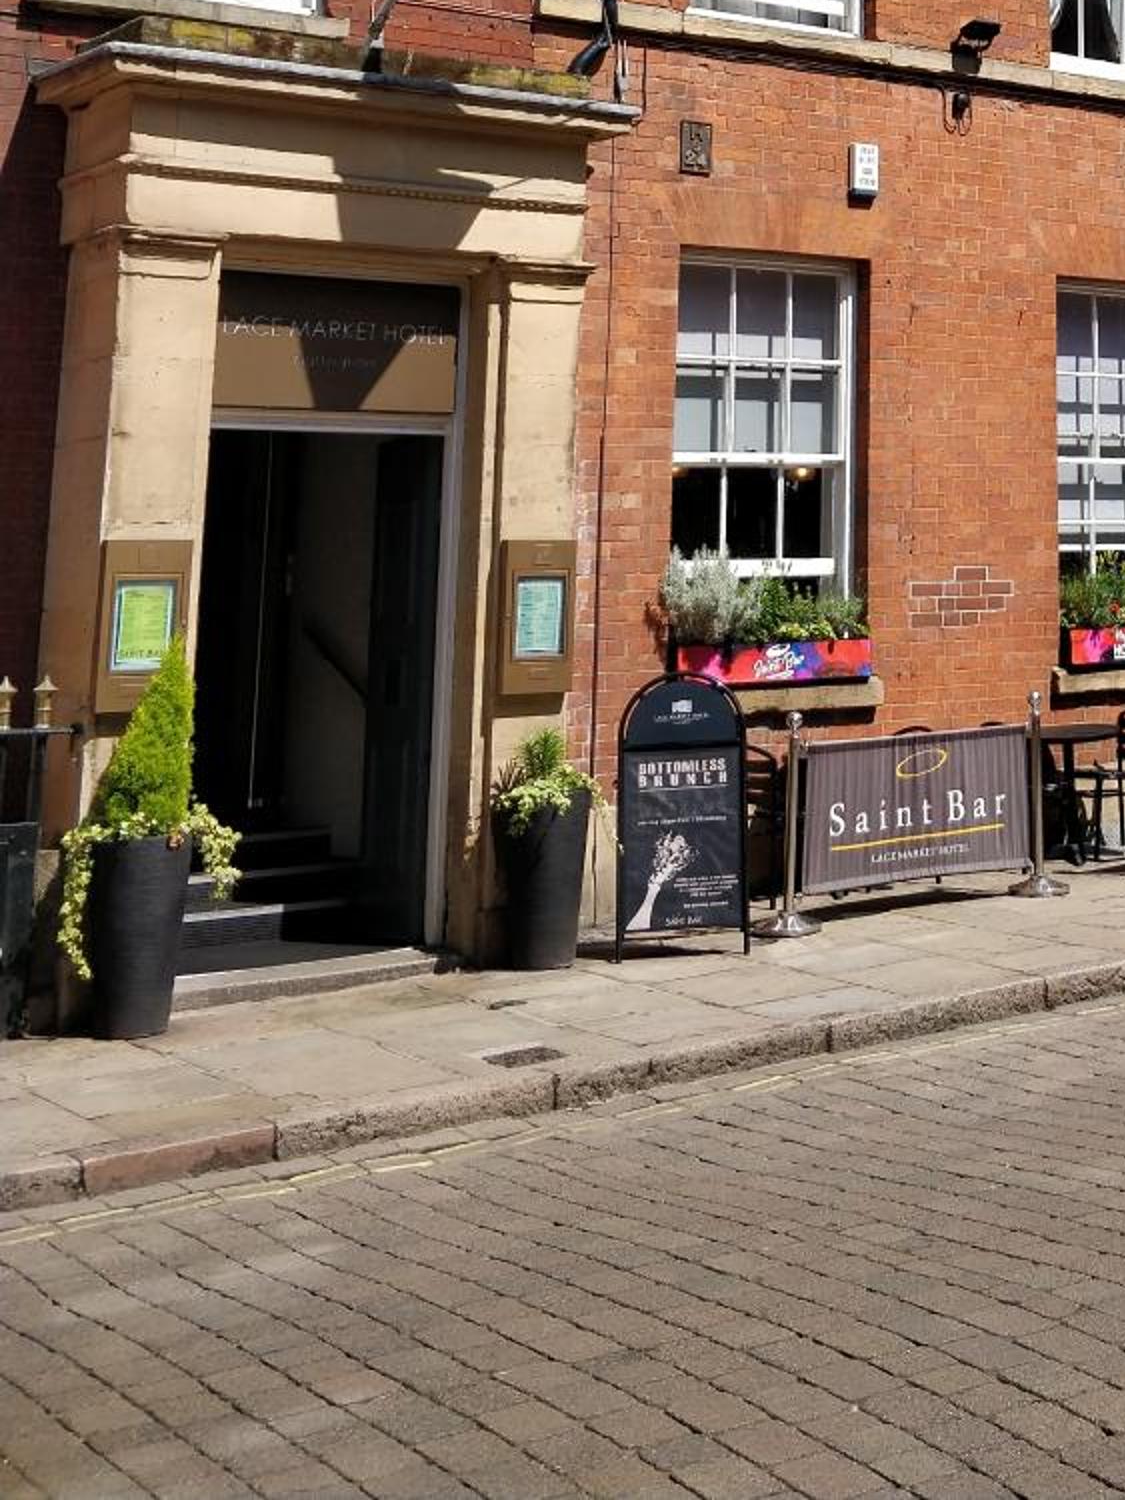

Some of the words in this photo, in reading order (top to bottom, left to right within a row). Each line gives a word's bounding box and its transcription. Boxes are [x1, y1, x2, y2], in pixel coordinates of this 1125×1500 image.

[222, 315, 282, 337] LACE
[289, 320, 376, 341] MARKET
[383, 324, 446, 345] HOTEL
[639, 757, 727, 775] BOTTOMLESS
[638, 771, 728, 789] BRUNCH
[829, 798, 934, 837] Saint
[947, 789, 1007, 822] Bar
